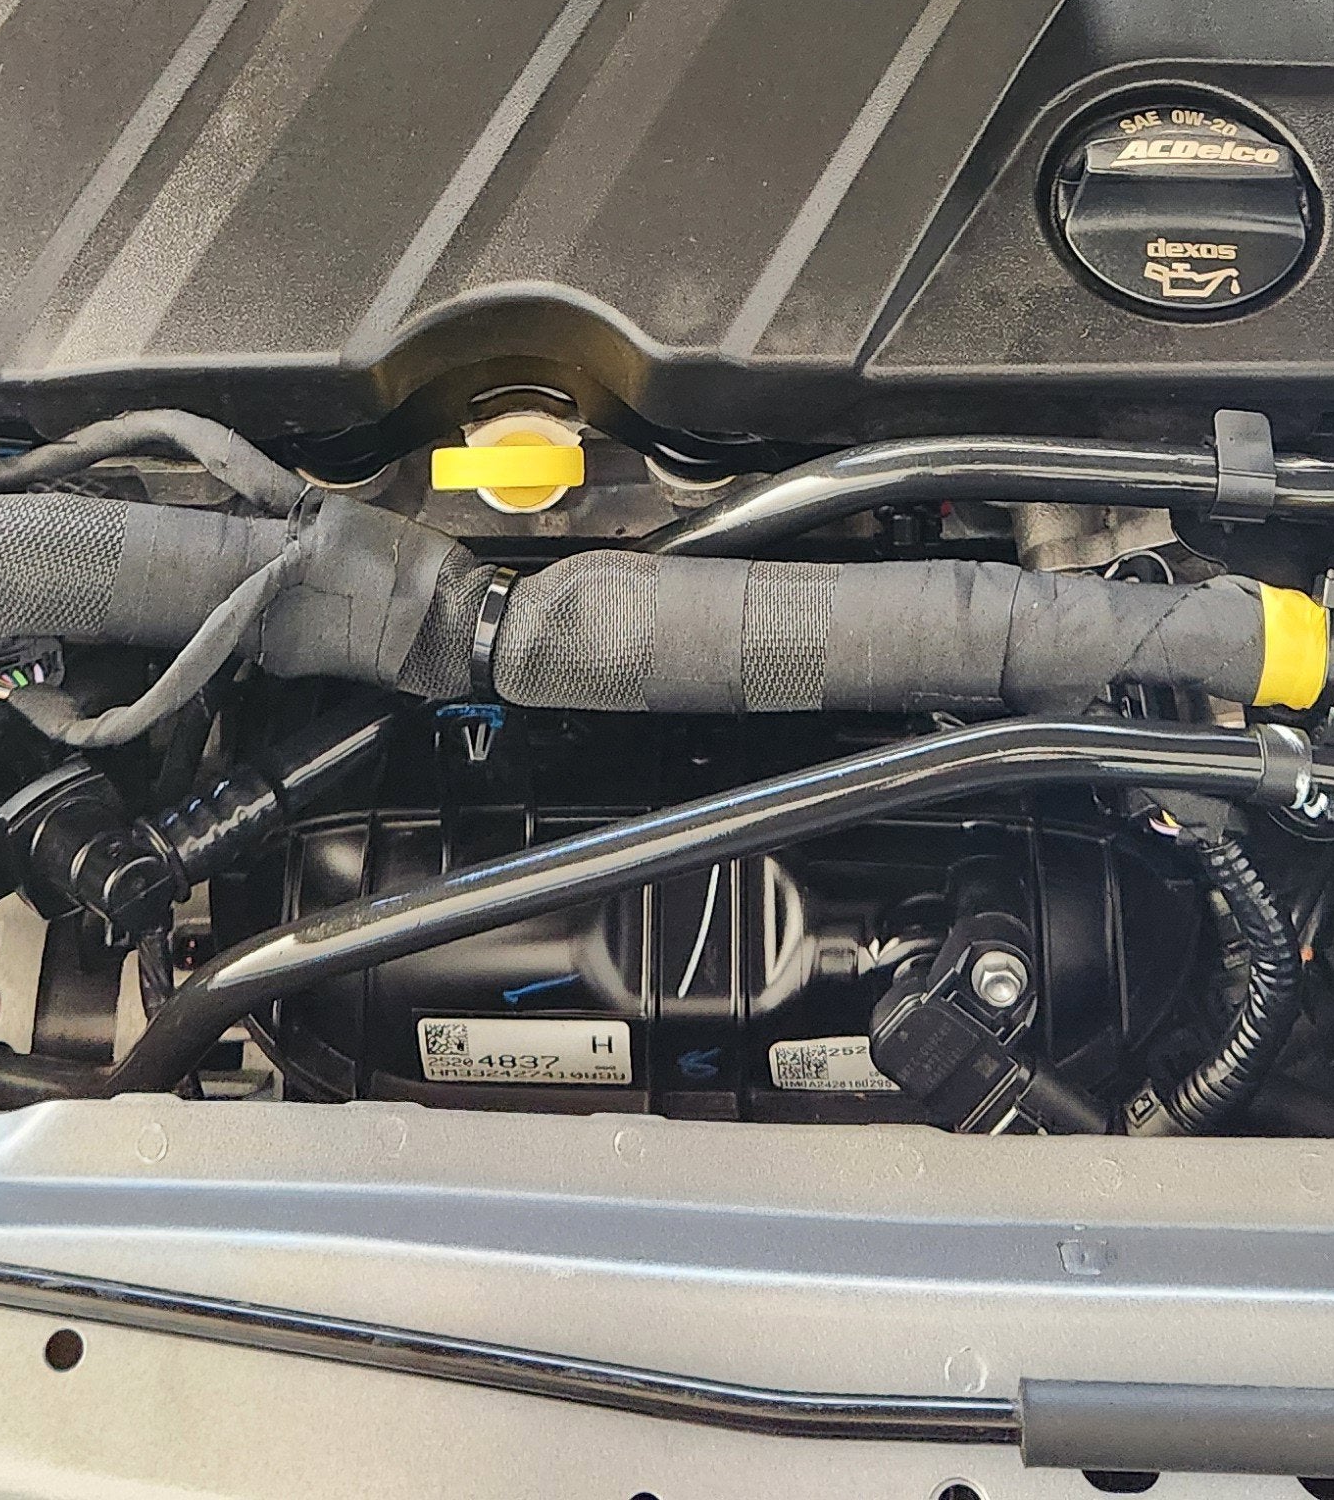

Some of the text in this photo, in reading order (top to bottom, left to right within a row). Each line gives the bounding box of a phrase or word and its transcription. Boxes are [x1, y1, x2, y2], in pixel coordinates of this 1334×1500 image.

[1119, 109, 1238, 137] SAE 0W-20
[1116, 139, 1281, 164] ACDelco
[1146, 237, 1238, 260] dexos
[591, 1035, 614, 1054] H
